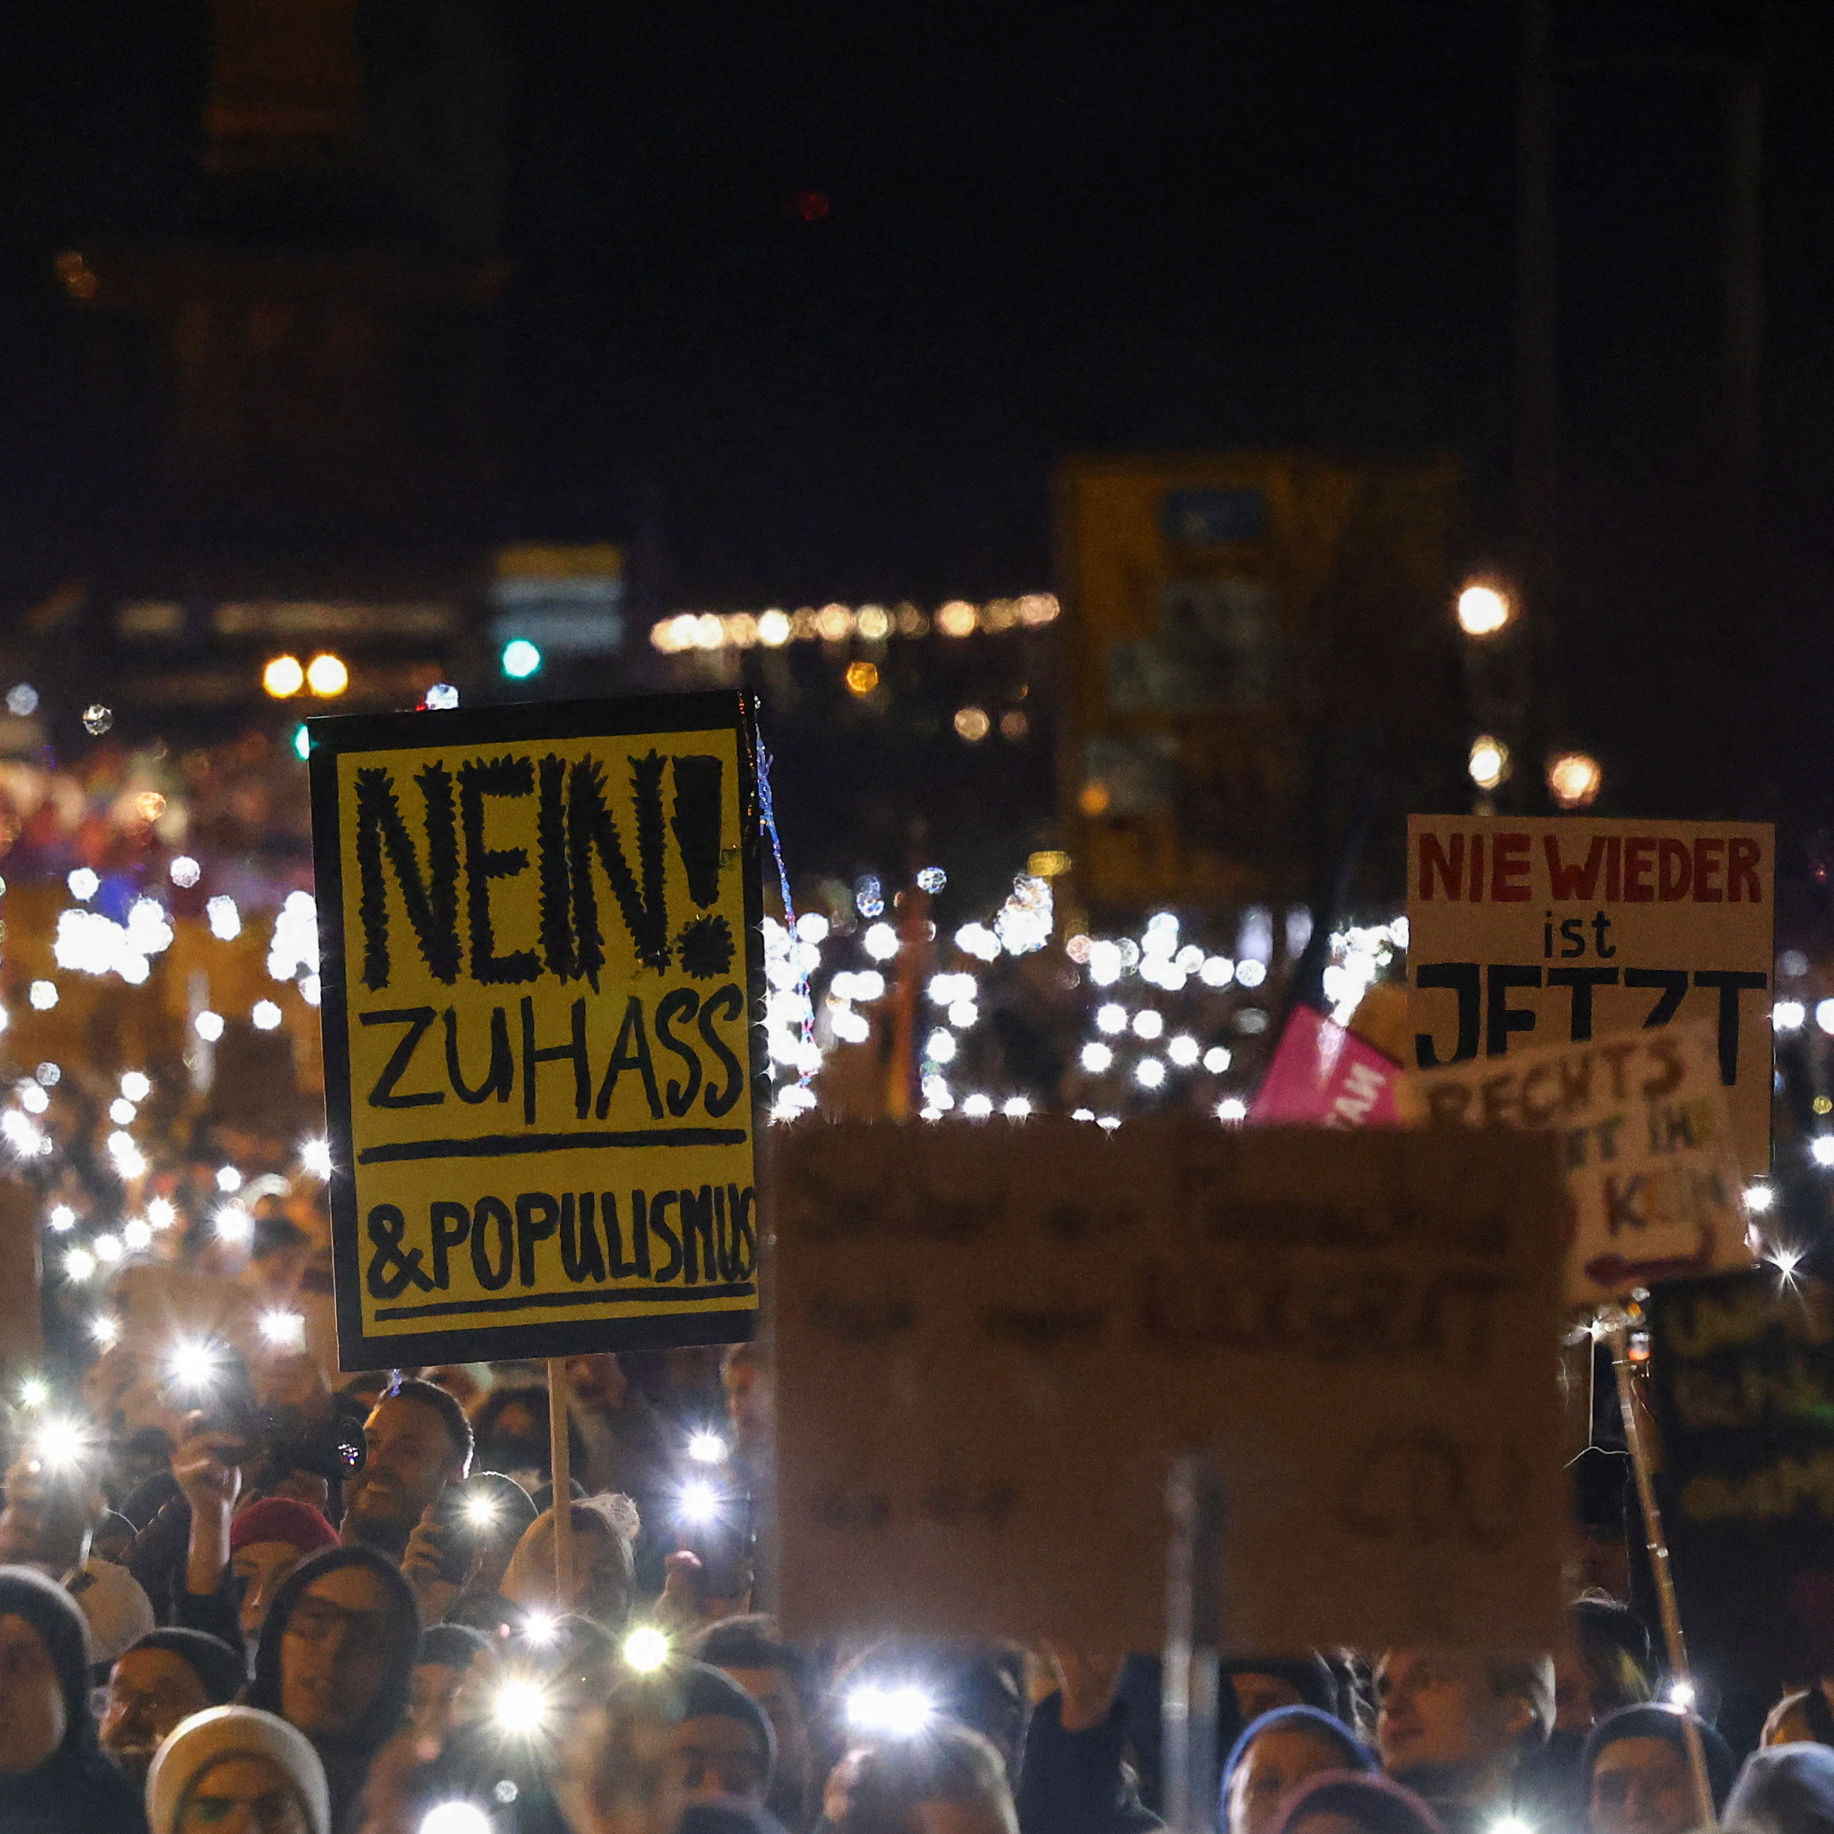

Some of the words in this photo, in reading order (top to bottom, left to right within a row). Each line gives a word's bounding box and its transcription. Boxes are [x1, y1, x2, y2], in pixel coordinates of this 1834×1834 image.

[352, 748, 737, 994] NEIN!
[1418, 832, 1532, 903] NIE
[1544, 835, 1764, 904] WIEDER
[1543, 909, 1617, 959] ist
